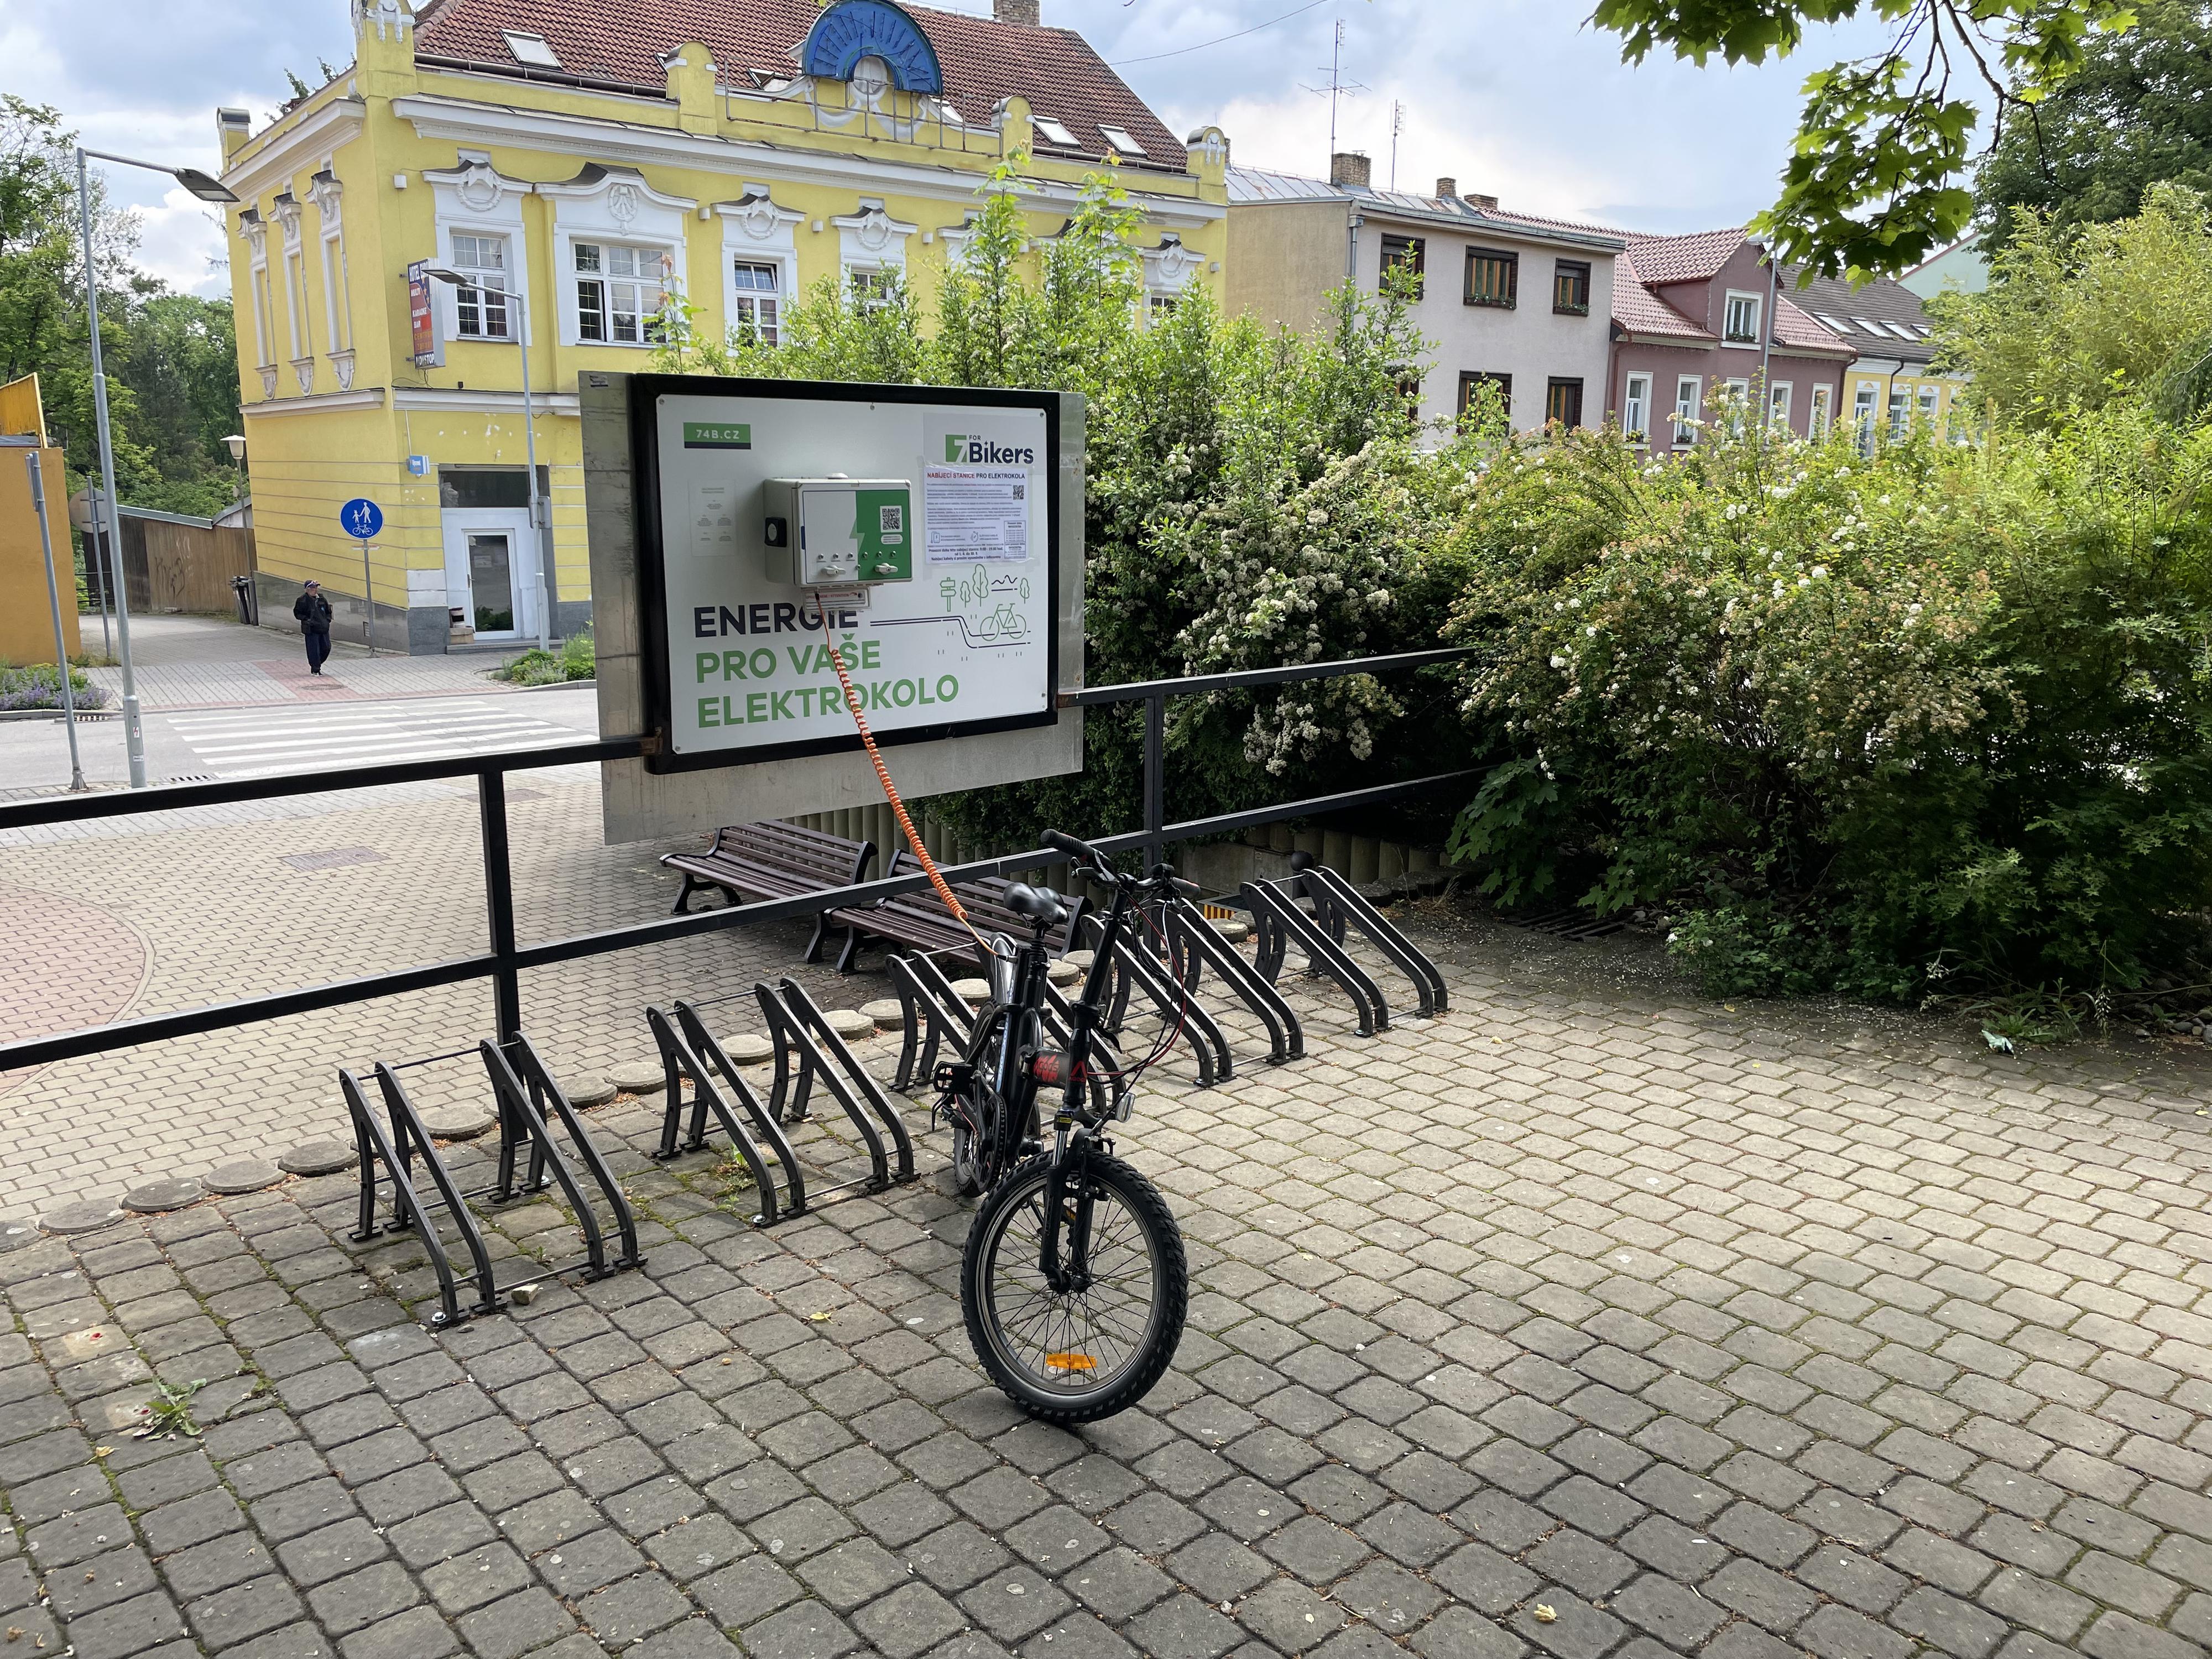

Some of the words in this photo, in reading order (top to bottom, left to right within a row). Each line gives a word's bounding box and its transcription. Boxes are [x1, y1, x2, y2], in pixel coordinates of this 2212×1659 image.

[696, 429, 739, 439] 74B.CZ
[969, 441, 1034, 464] Bikers
[695, 602, 858, 638] ENERGIE
[696, 648, 776, 683] PRO
[786, 633, 880, 675] VAŠE
[698, 674, 958, 728] ELEKTROKOLO
